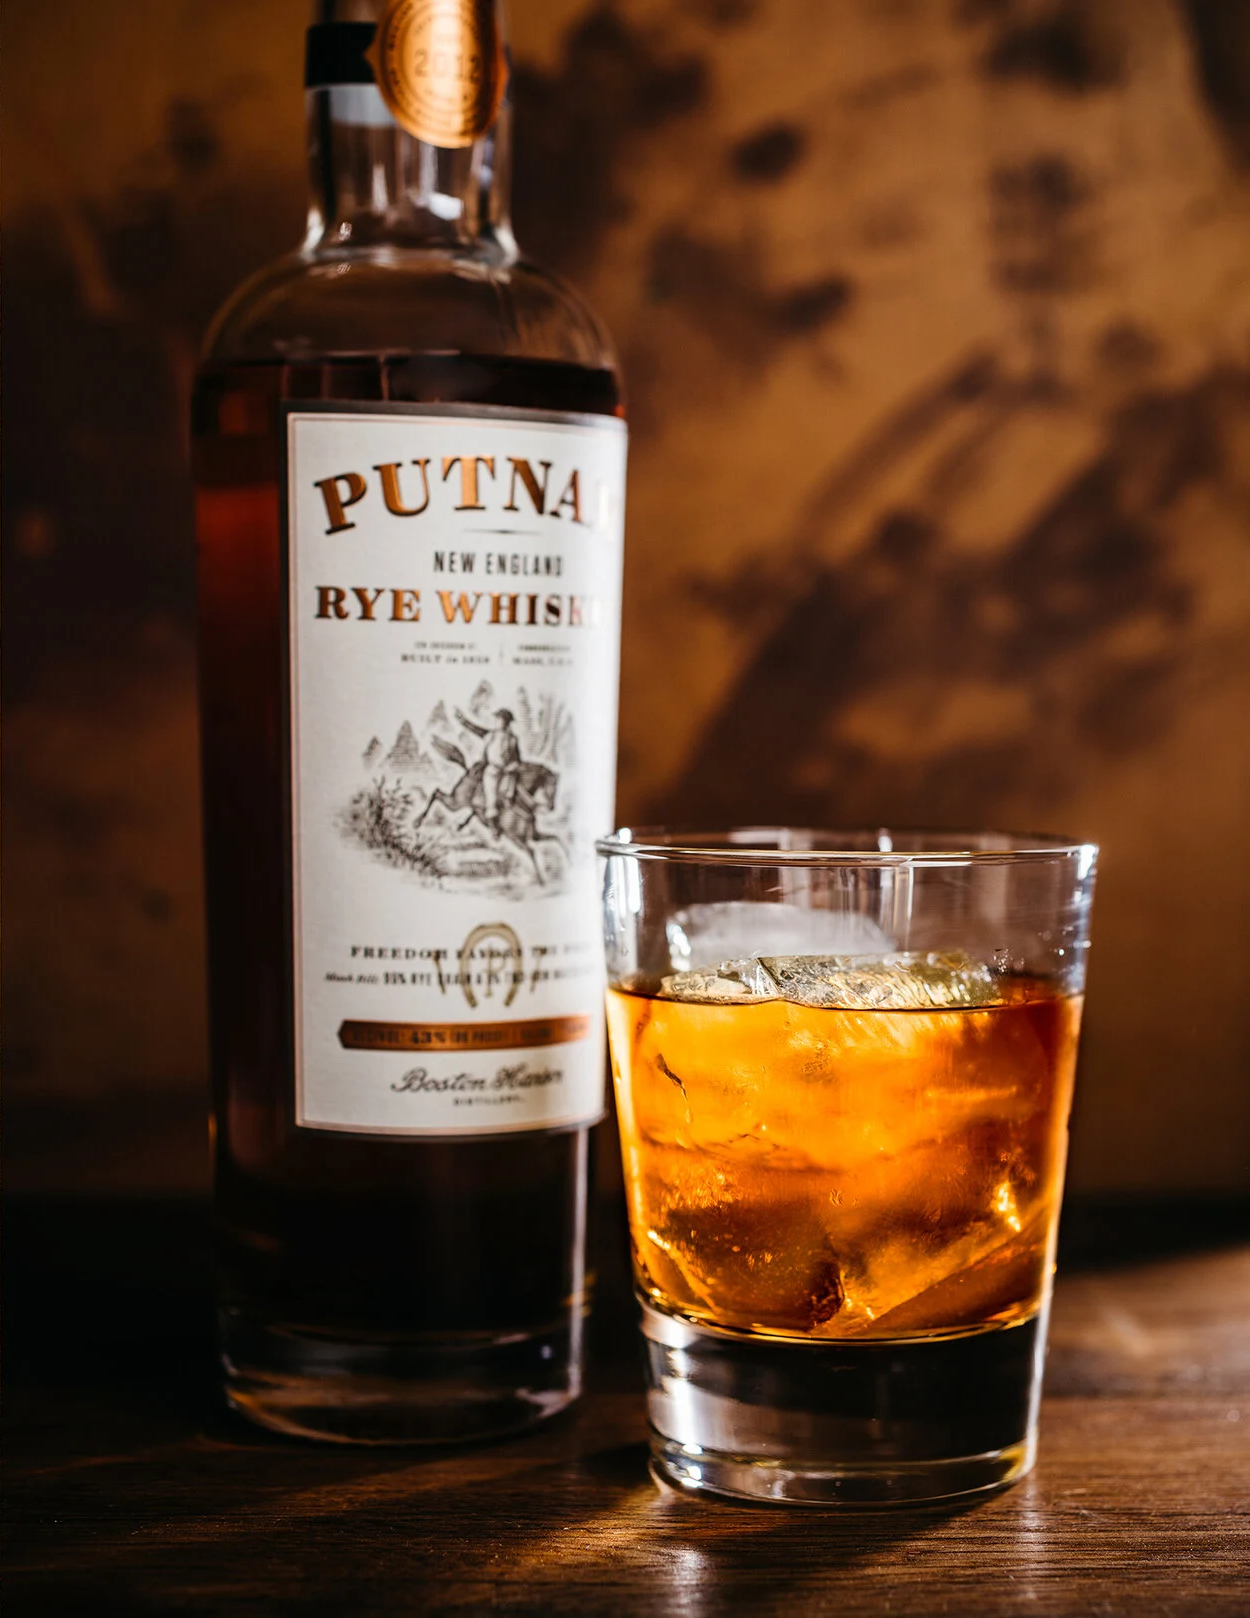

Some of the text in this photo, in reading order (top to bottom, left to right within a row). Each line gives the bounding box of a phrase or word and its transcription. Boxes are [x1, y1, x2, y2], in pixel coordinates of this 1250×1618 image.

[313, 455, 586, 537] PUTNA
[434, 551, 565, 578] NEW ENGLAND
[314, 585, 591, 628] RYE WHISK
[390, 1066, 486, 1094] Boston
